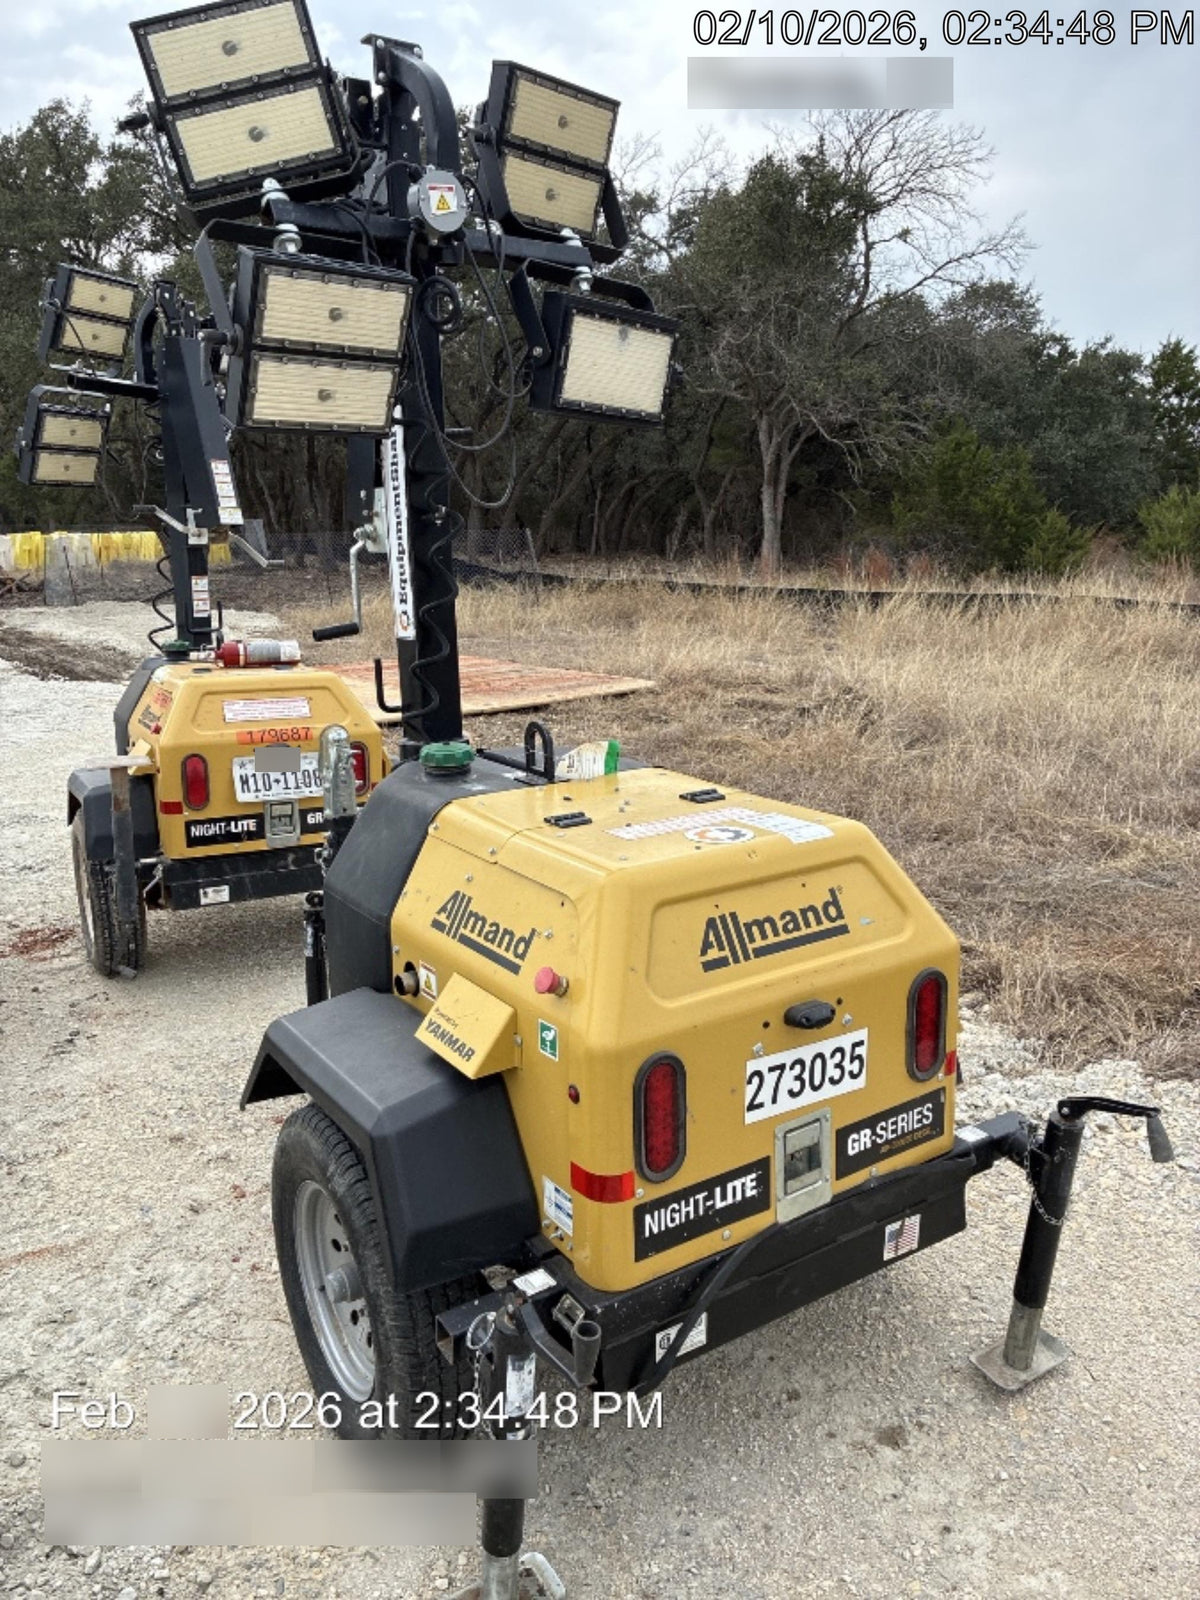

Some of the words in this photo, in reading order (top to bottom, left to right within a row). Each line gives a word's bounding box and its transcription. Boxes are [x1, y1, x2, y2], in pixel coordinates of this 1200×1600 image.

[390, 430, 408, 605] EquipmentShar
[246, 726, 311, 743] 179687
[190, 819, 257, 838] NIGHT-LITE
[435, 890, 537, 962] Allmand
[700, 886, 845, 965] Allmand
[425, 1018, 476, 1062] YANMAR
[746, 1039, 865, 1113] 273035
[847, 1103, 933, 1156] GR-SERIES
[643, 1172, 760, 1239] NIGHT-LITE
